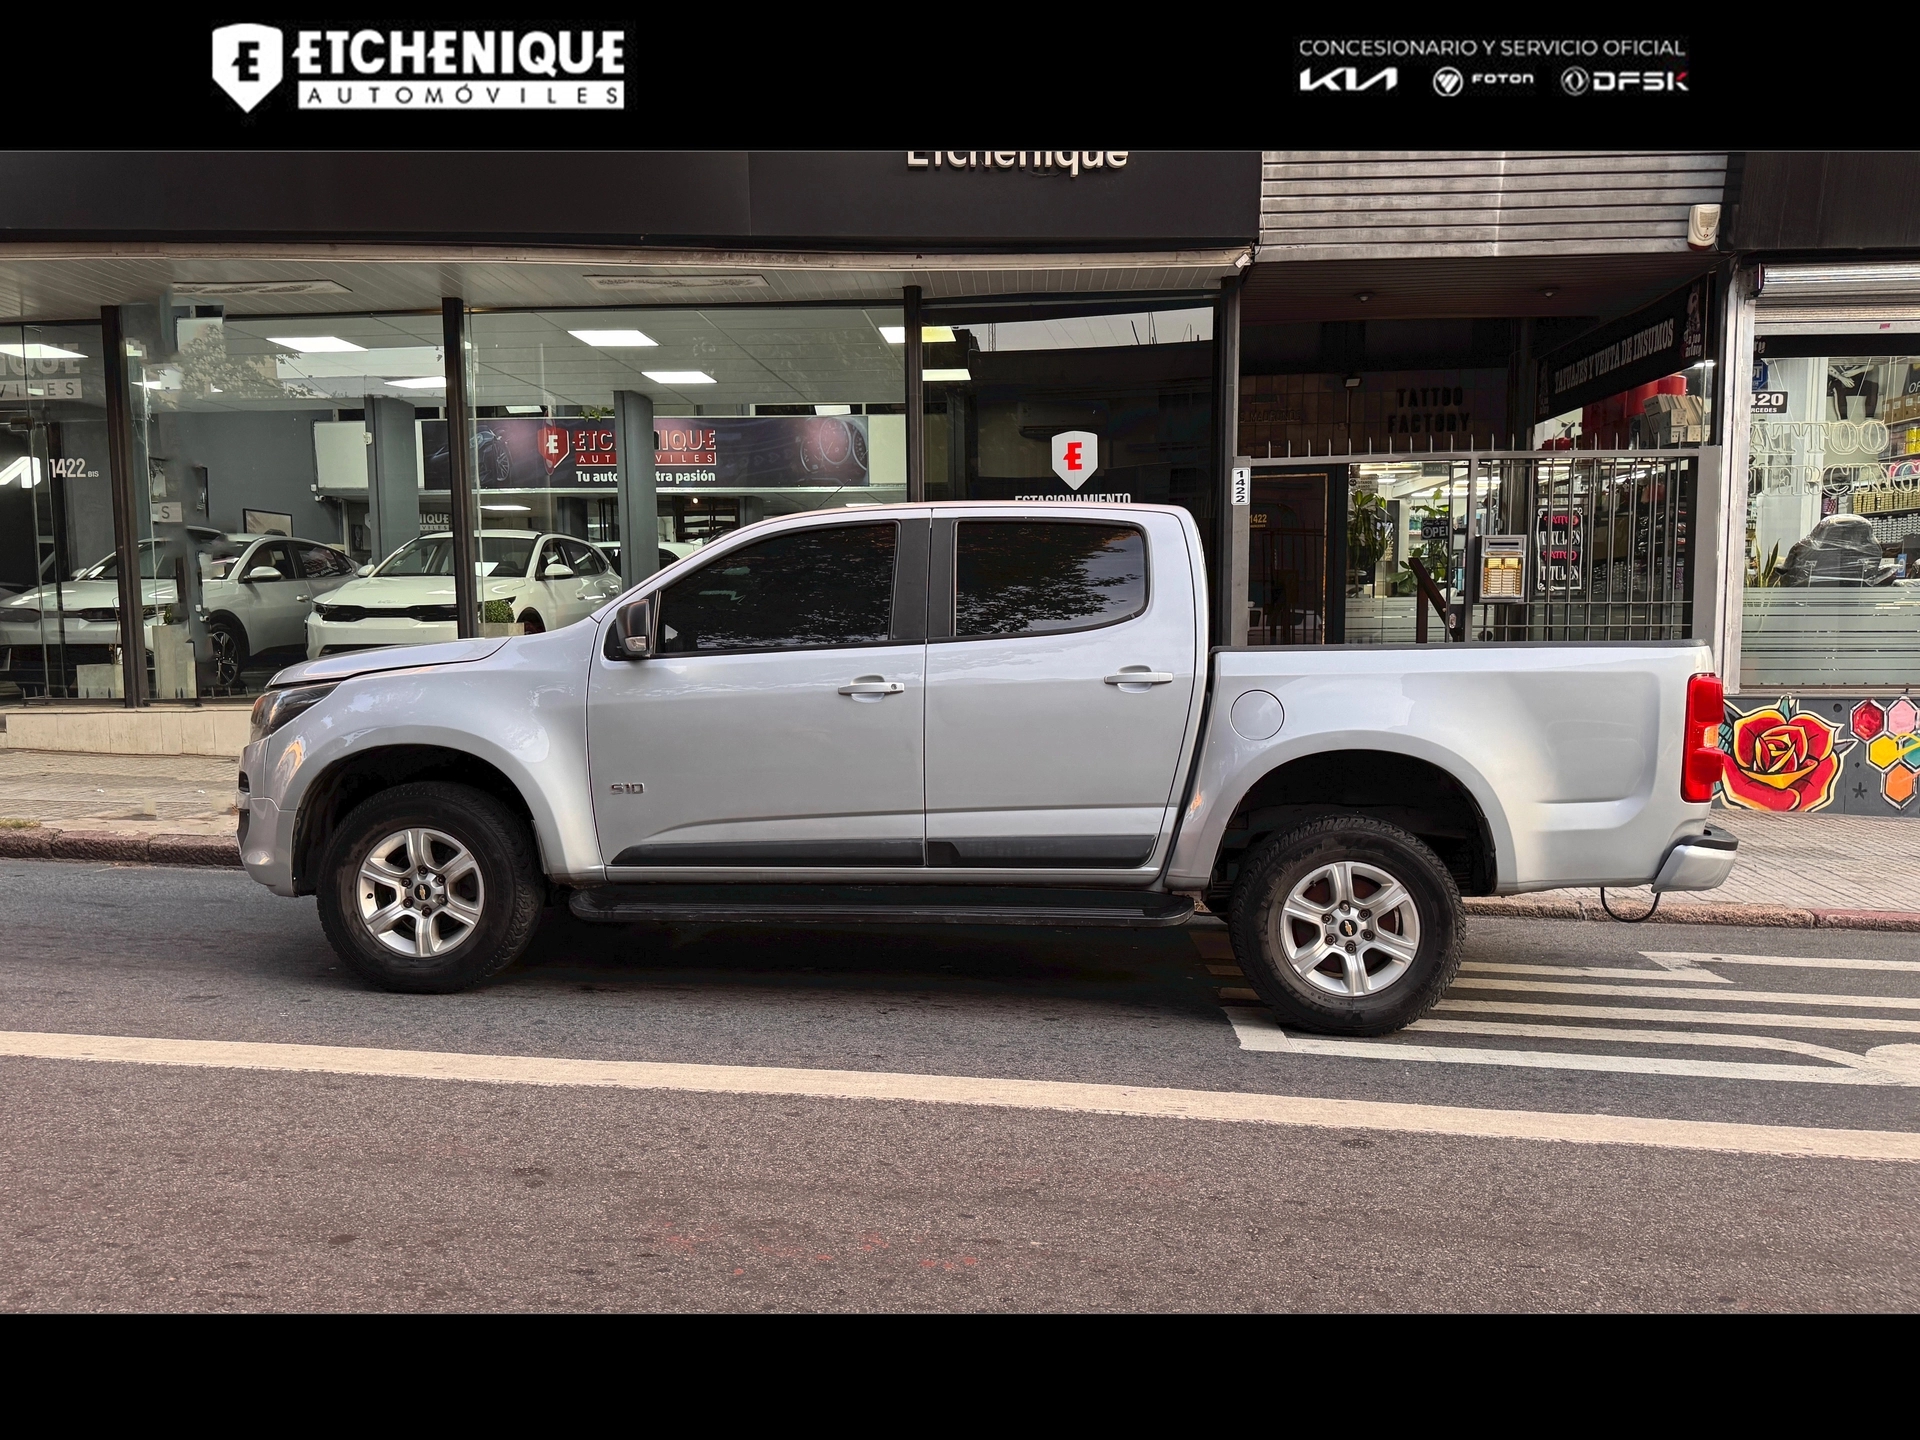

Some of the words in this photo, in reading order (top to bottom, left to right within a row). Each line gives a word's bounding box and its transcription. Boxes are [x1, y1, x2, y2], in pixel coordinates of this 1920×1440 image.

[1555, 356, 1587, 394] TATUAJES
[1594, 342, 1620, 377] VENTA
[1620, 336, 1633, 366] DE
[1634, 317, 1675, 360] INSUMOS
[1397, 387, 1463, 408] TATTOO
[1388, 413, 1470, 434] FACTORY
[50, 457, 86, 478] 1422
[576, 470, 591, 483] Tu
[675, 469, 716, 485] pasión
[1235, 470, 1246, 503] 1422
[1249, 514, 1267, 524] 1422
[611, 783, 645, 795] S10
